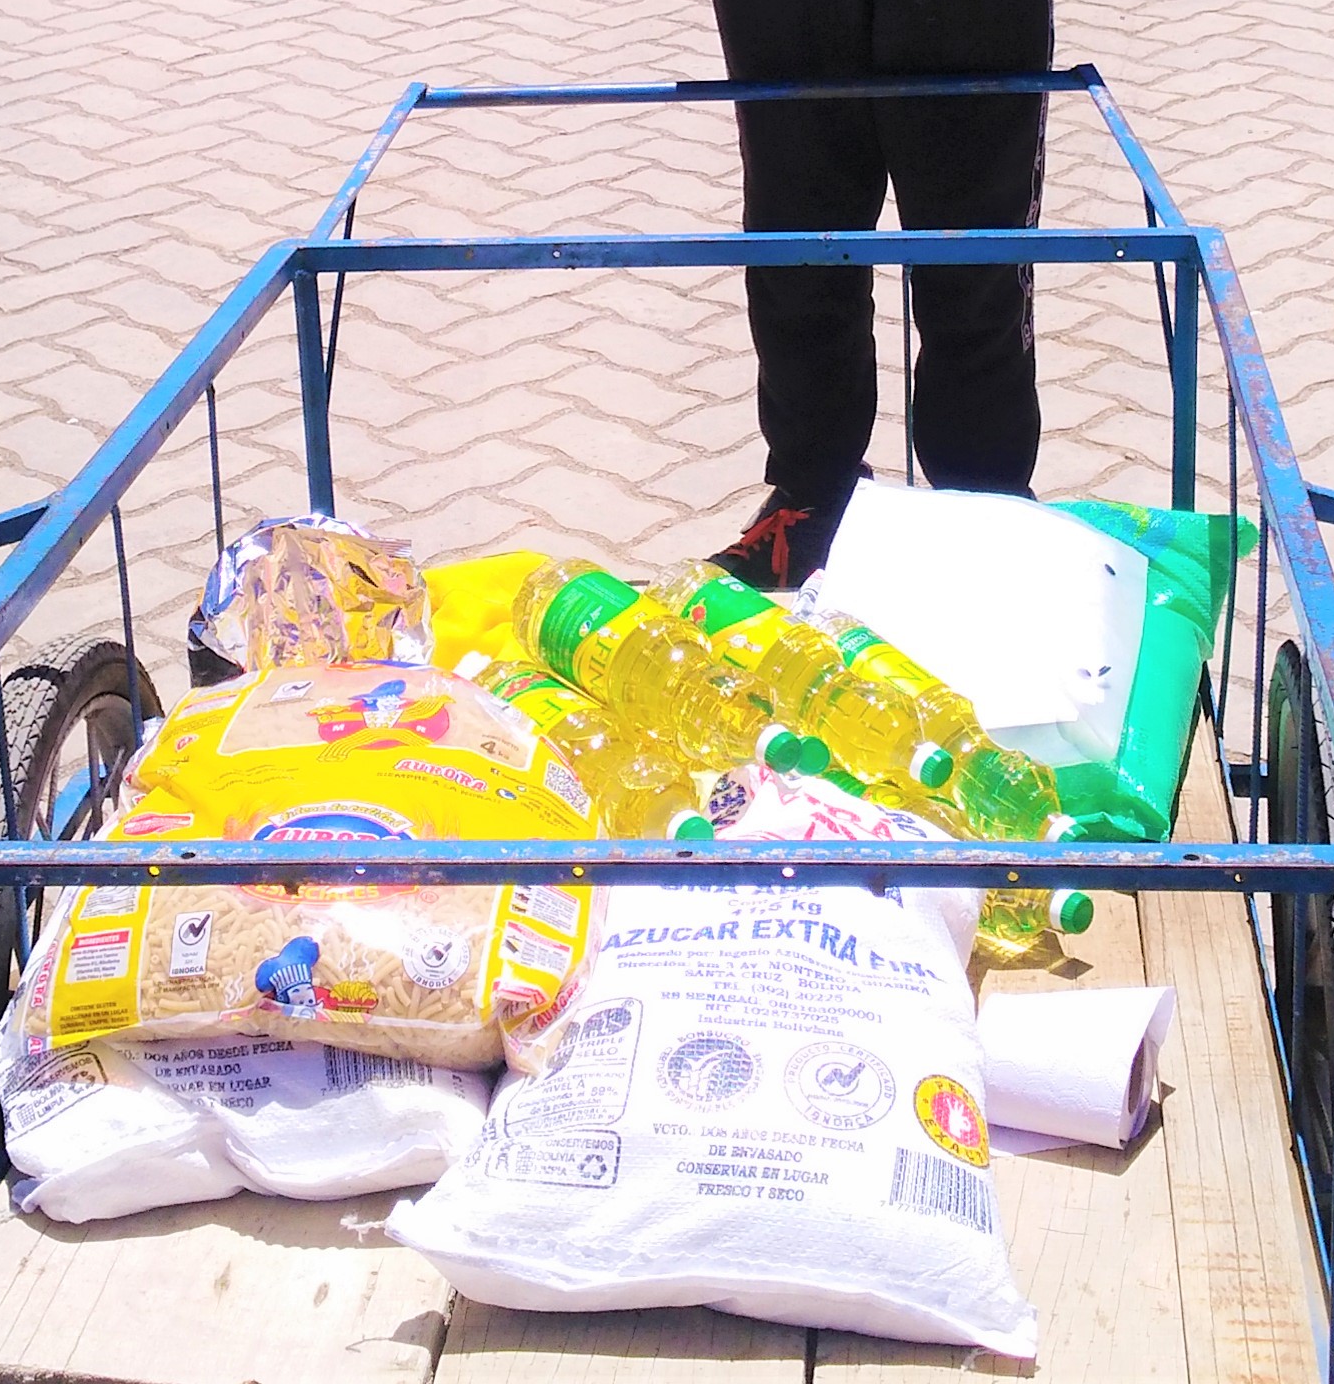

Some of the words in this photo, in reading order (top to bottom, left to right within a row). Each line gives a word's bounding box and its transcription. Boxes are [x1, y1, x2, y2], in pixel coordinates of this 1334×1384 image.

[395, 759, 488, 792] AURORA
[792, 899, 822, 916] kg
[600, 920, 740, 952] AZUCAR
[751, 918, 859, 967] EXTRA
[684, 969, 736, 978] SANTA
[741, 971, 783, 982] CRUZ
[797, 978, 861, 994] BOLIVIA
[768, 960, 846, 983] MONTERO
[698, 1014, 767, 1028] Industria
[773, 1020, 844, 1038] Boliviana
[208, 1045, 249, 1059] DESDE
[252, 1040, 295, 1055] FECHA
[575, 1046, 618, 1058] SELLO
[579, 1036, 626, 1049] TRIPLE
[155, 1066, 172, 1077] DE
[175, 1063, 242, 1077] ENVASADO
[840, 1046, 892, 1099] CERTIFICADO
[230, 1076, 272, 1093] LUGAR
[700, 1126, 727, 1138] DOS
[772, 1129, 817, 1146] DESDE
[821, 1137, 865, 1153] FECHA
[708, 1144, 727, 1157] DE
[731, 1145, 803, 1163] ENVASADO
[676, 1161, 758, 1179] CONSERVAR
[761, 1166, 781, 1180] EN
[783, 1167, 830, 1185] LUGAR
[697, 1182, 752, 1198] FRESCO
[755, 1185, 766, 1198] Y
[769, 1186, 805, 1202] SECO
